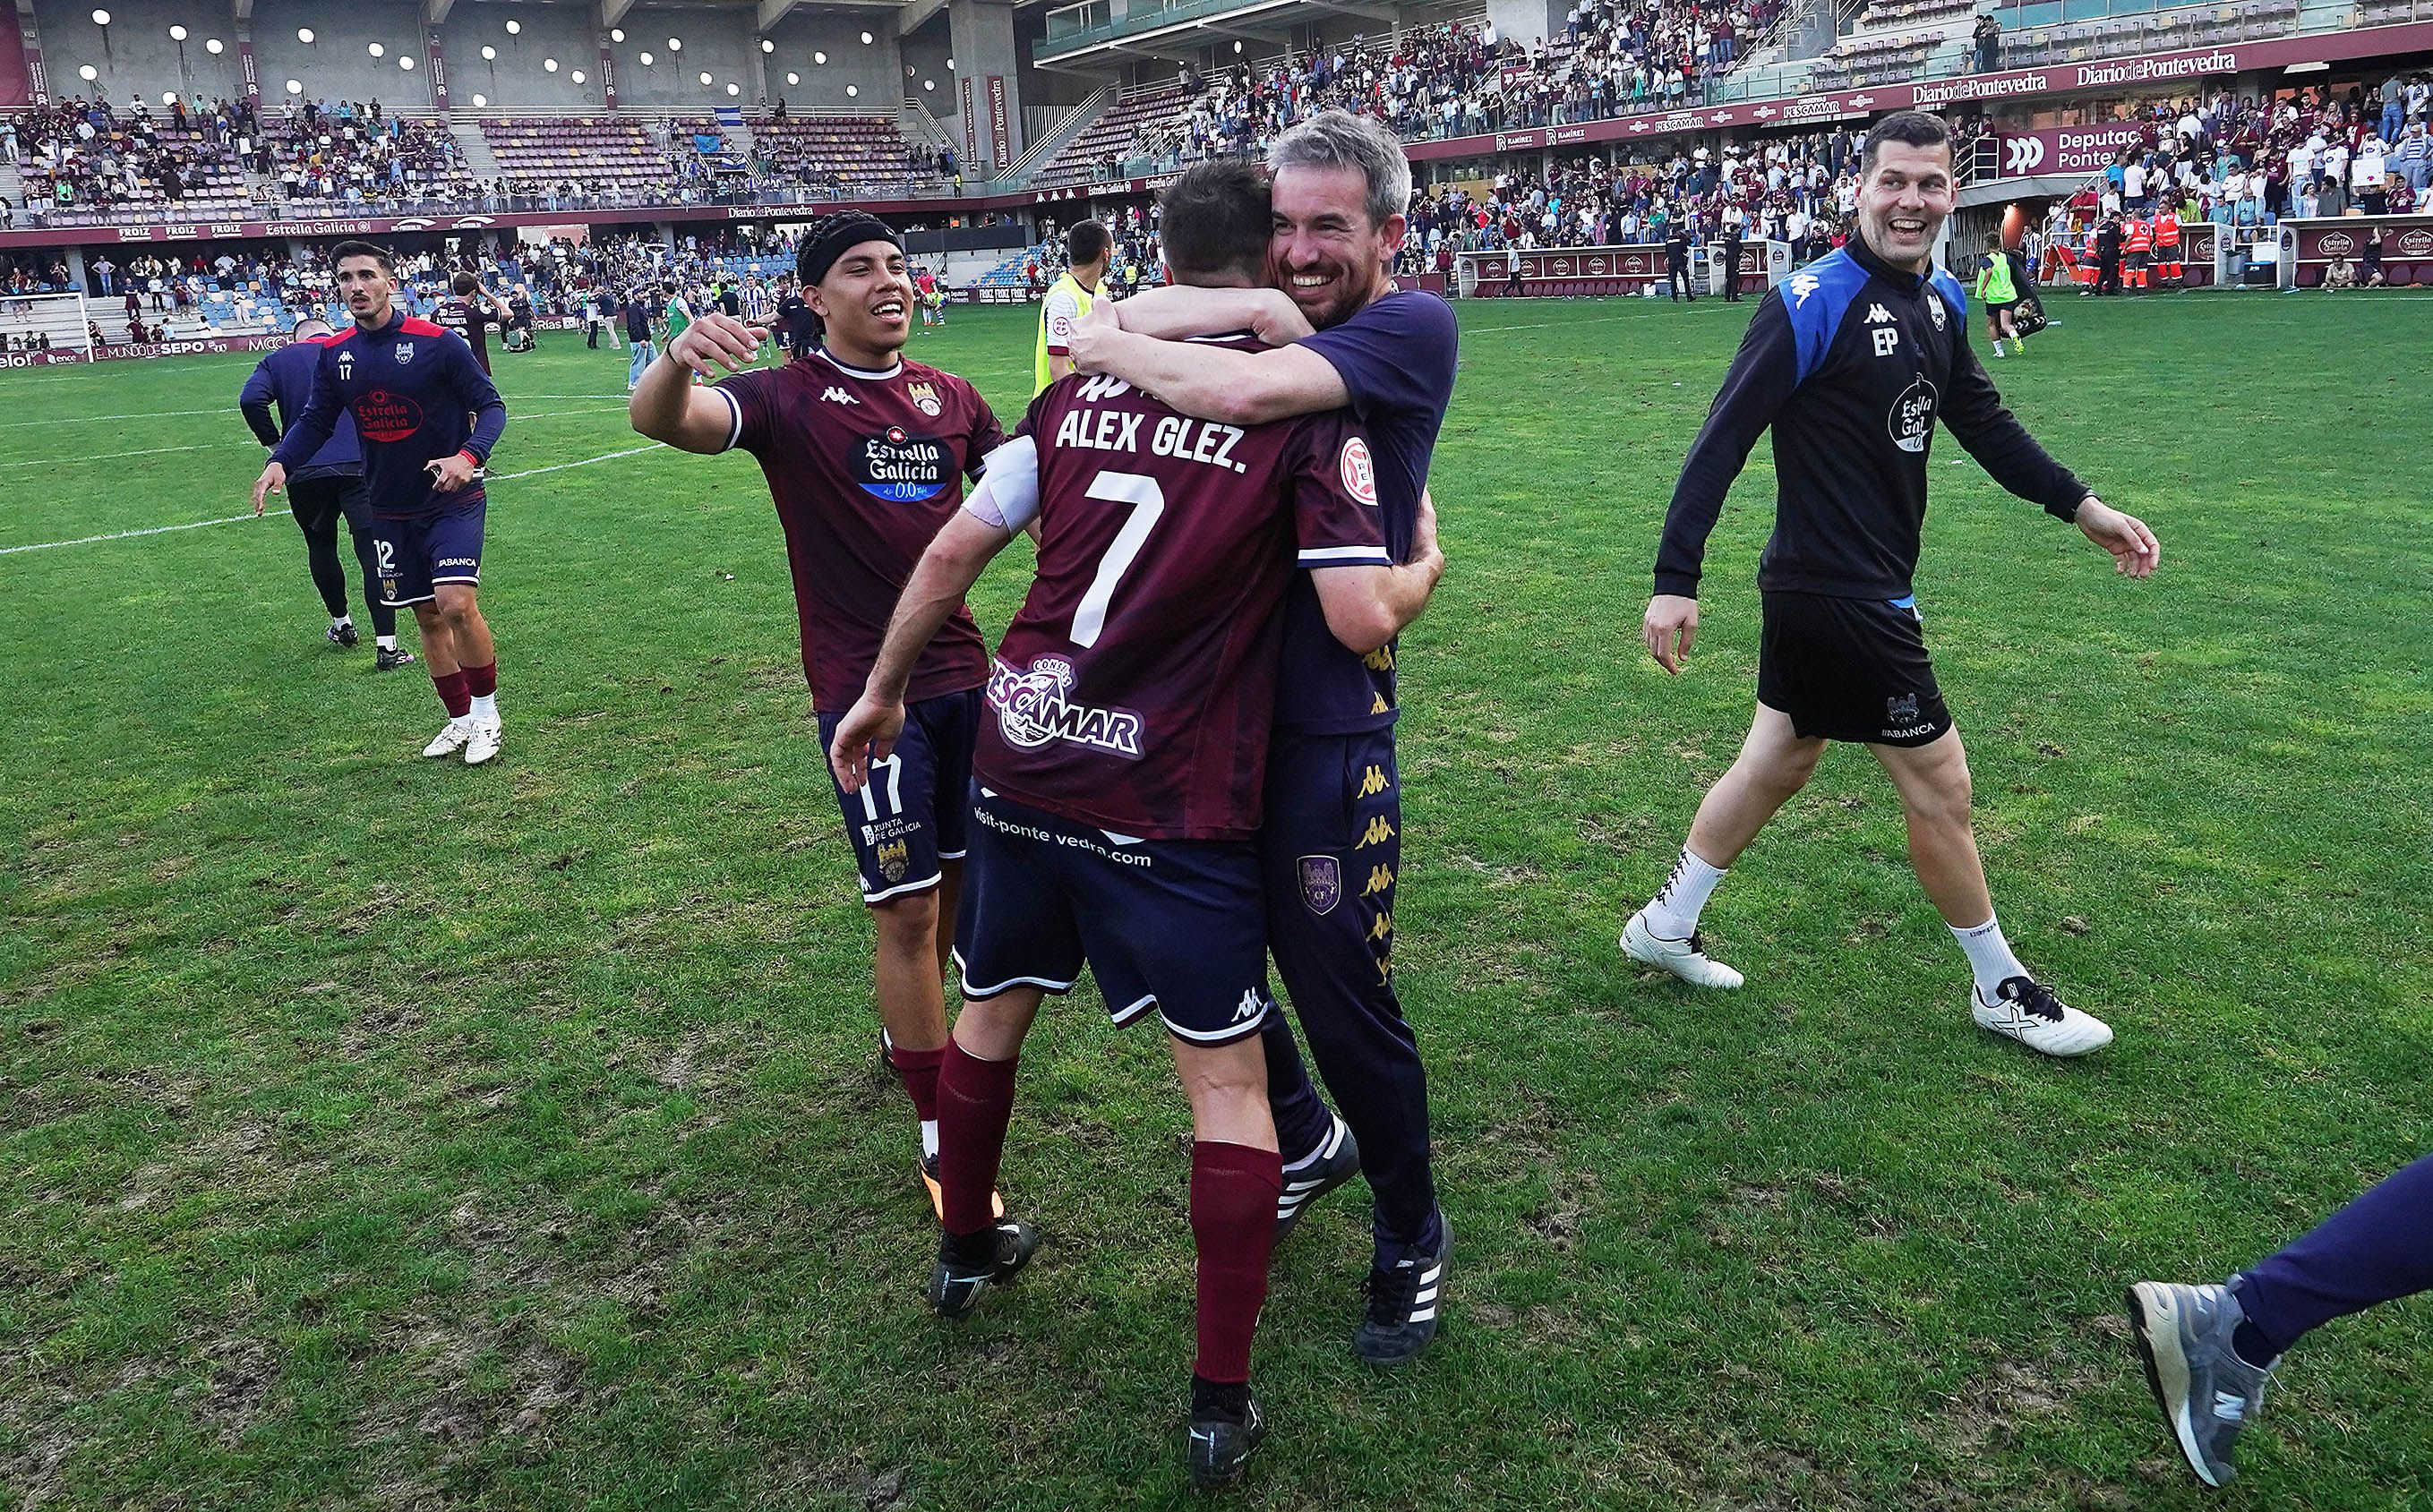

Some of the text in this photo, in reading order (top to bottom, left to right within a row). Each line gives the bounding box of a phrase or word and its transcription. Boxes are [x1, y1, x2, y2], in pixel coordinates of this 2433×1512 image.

[1784, 101, 1840, 118] PESCAMAR
[1655, 116, 1704, 132] PESCAMAR
[119, 227, 150, 237] FROIZ
[165, 226, 197, 235] FROIZ
[211, 225, 243, 234] FROIZ
[266, 222, 356, 235] Estrella Galicia
[161, 341, 205, 355] SEPO
[1872, 328, 1899, 356] EP
[56, 355, 77, 363] ence
[338, 364, 352, 380] 17
[359, 405, 407, 417] Estrella
[364, 416, 407, 429] Galicia
[1056, 410, 1247, 474] ALEX GLEZ.
[870, 460, 938, 481] Galicia
[373, 540, 395, 568] 12
[1069, 470, 1165, 649] 7
[441, 558, 476, 567] ABANCA
[1886, 722, 1936, 738] ABANCA
[861, 754, 903, 821] 17
[874, 818, 903, 833] XUNTA
[875, 822, 921, 841] DE GALICIA
